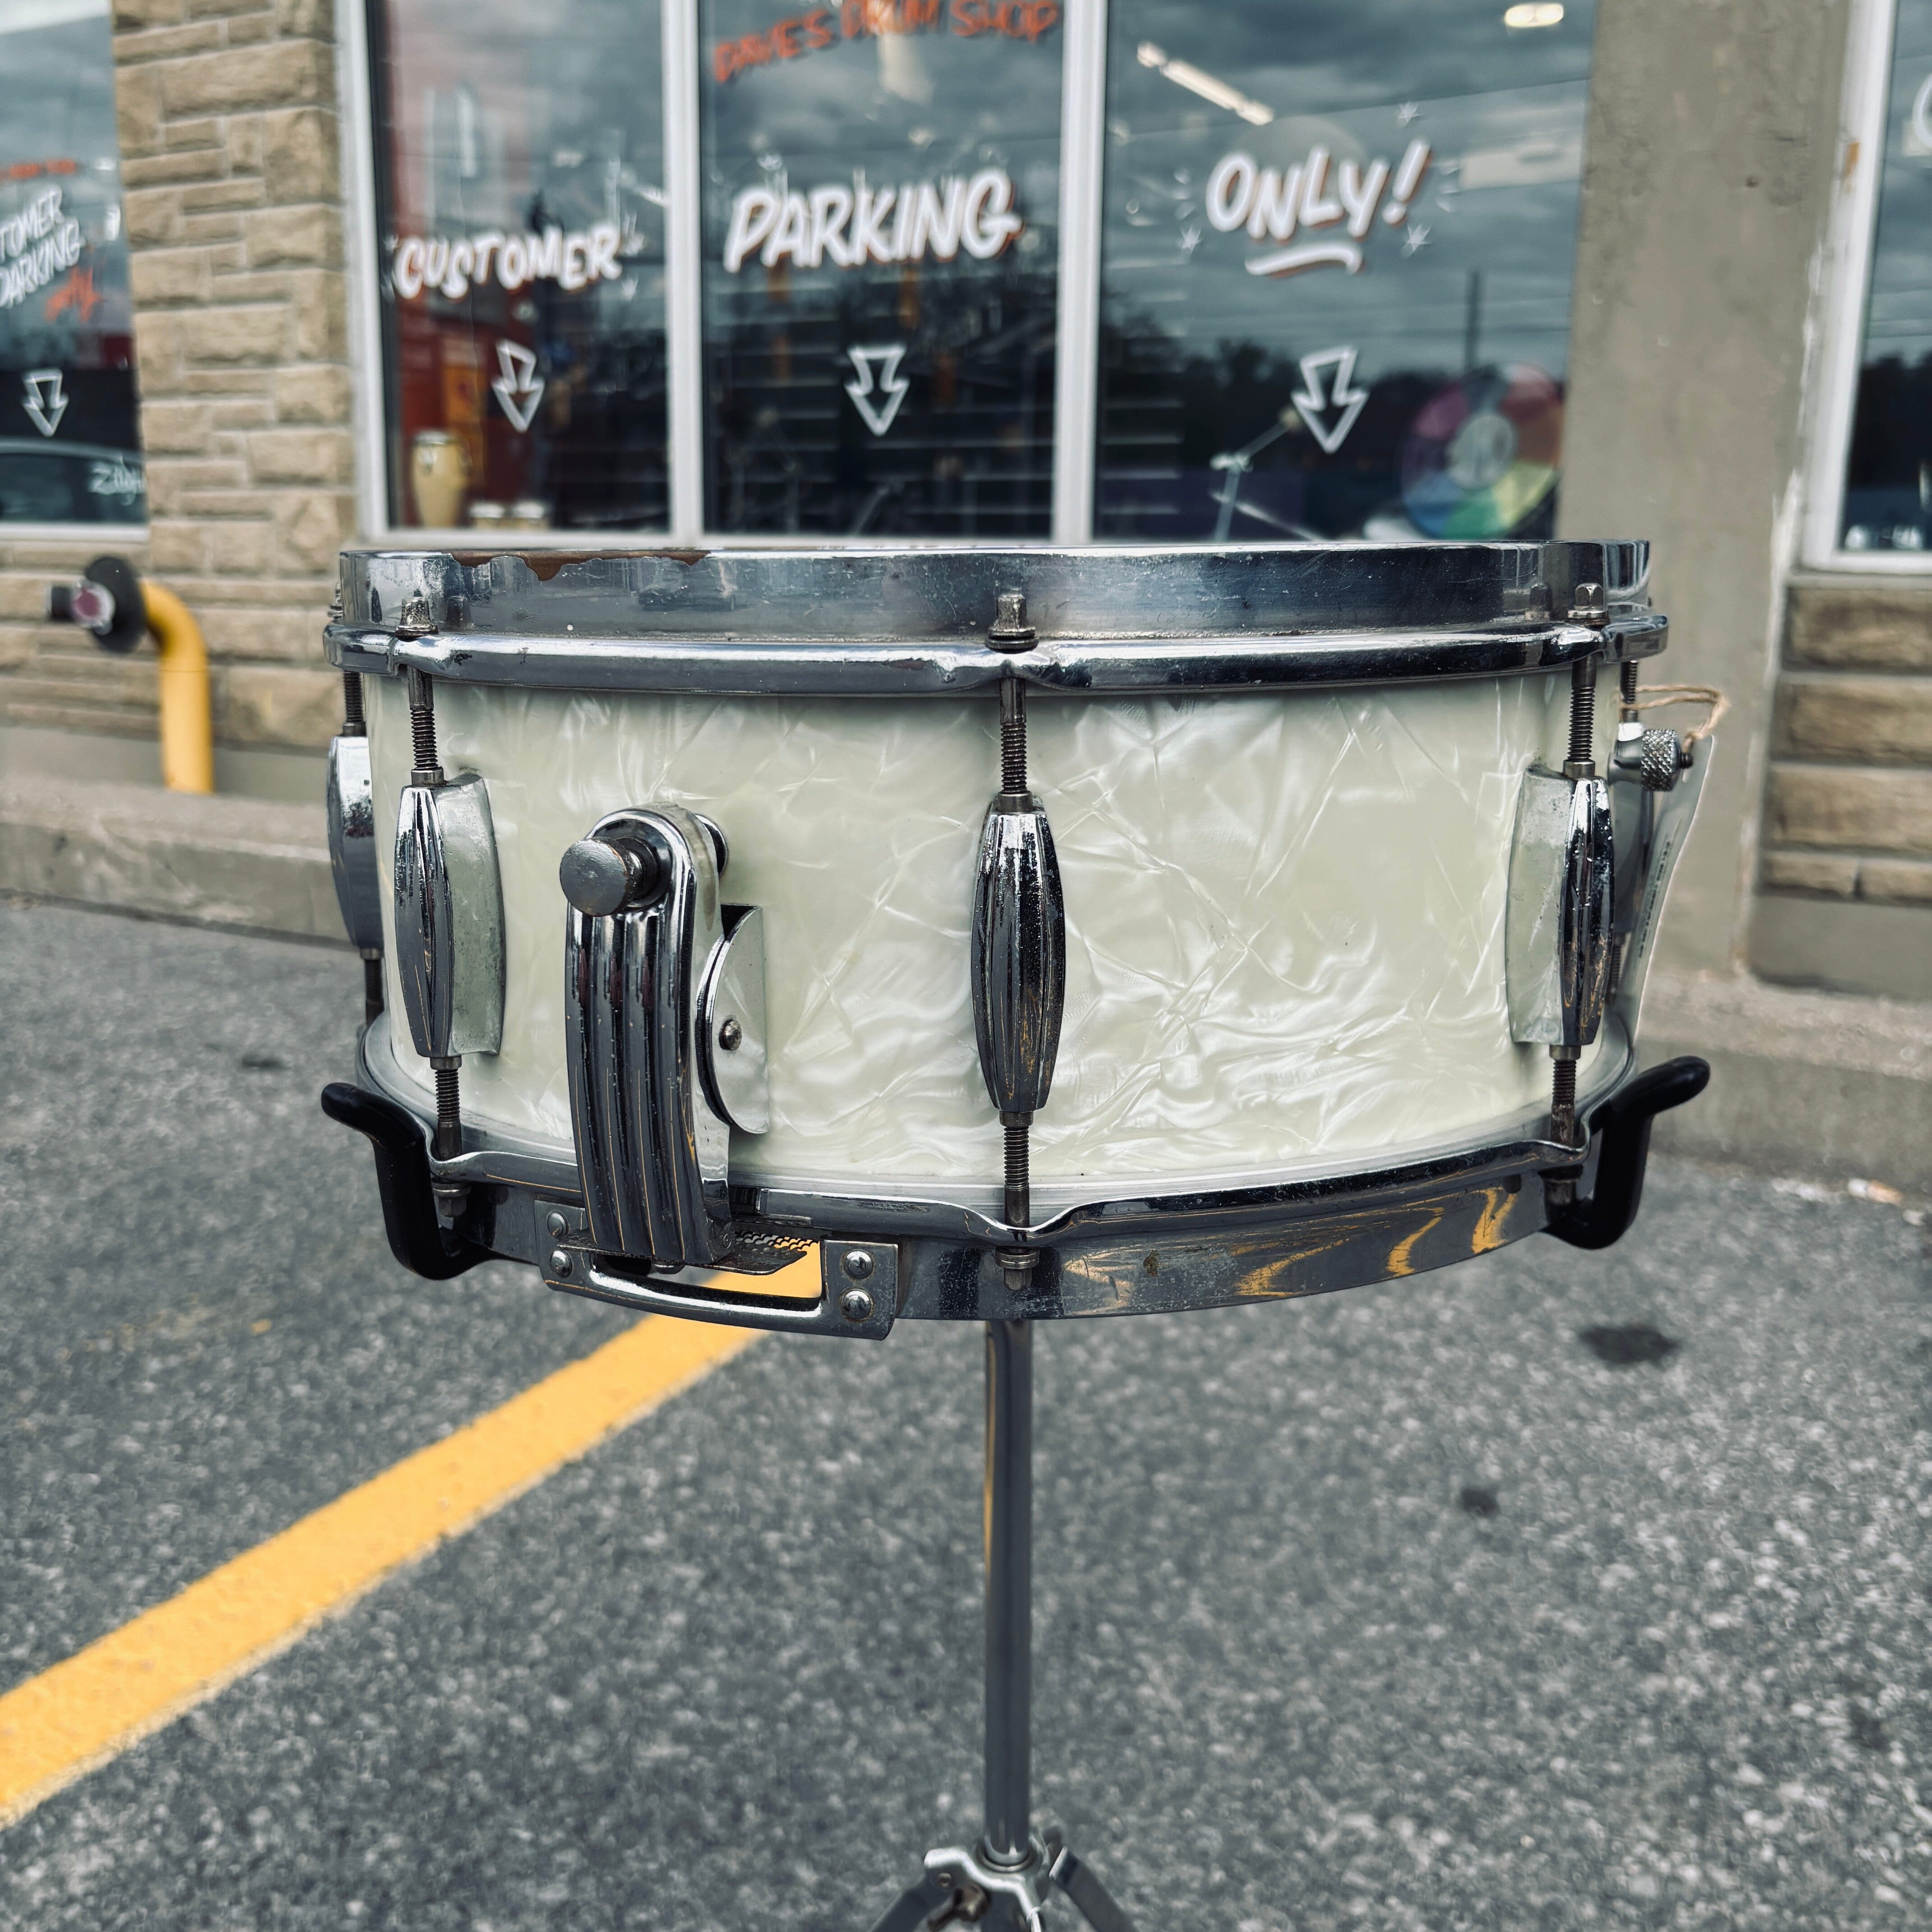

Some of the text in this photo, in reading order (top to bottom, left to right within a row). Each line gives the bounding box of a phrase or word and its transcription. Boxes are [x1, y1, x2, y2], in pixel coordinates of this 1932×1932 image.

[394, 137, 1431, 299] CUSTOMER PARKING ONLY!
